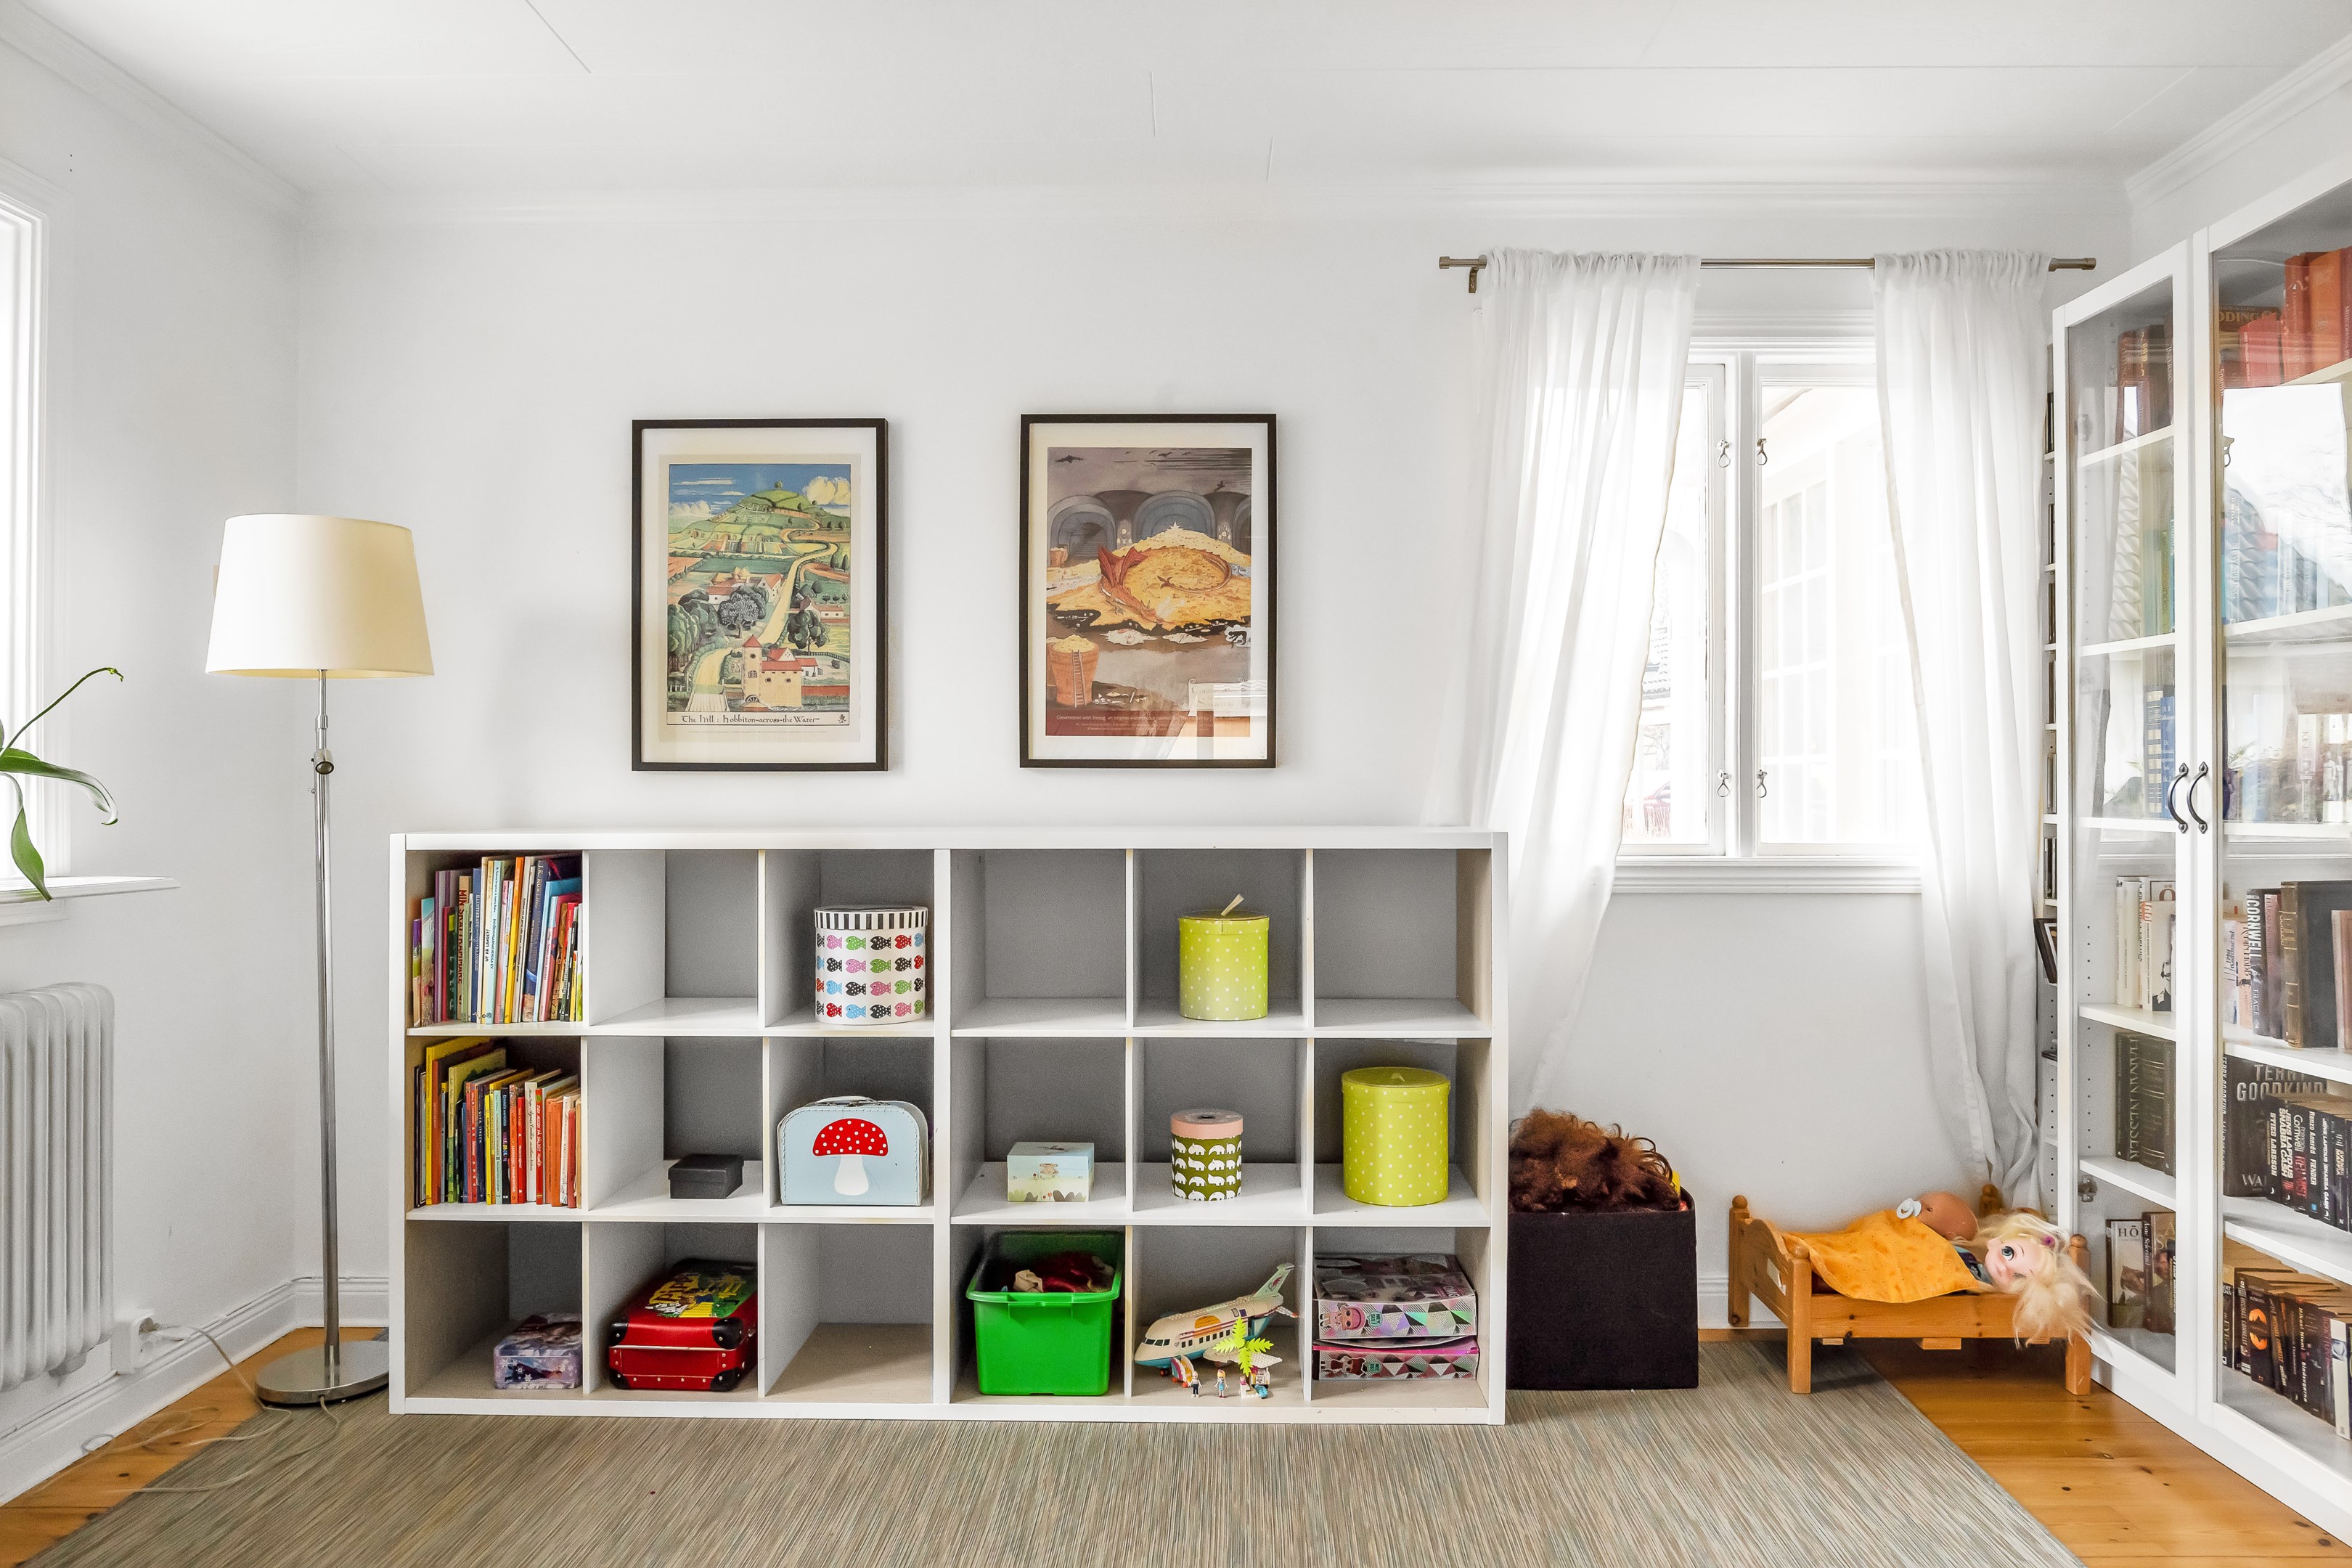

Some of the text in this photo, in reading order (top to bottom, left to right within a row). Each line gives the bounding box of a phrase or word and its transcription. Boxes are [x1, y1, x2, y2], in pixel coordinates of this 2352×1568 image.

[682, 714, 696, 723] The
[459, 889, 467, 906] MIN
[2247, 900, 2262, 957] CORNWELL
[2237, 1082, 2324, 1101] GOODKIND
[2129, 1098, 2139, 1160] NESSER
[2279, 1108, 2289, 1177] SNABBA CASH
[2293, 1114, 2303, 1152] Cornwell
